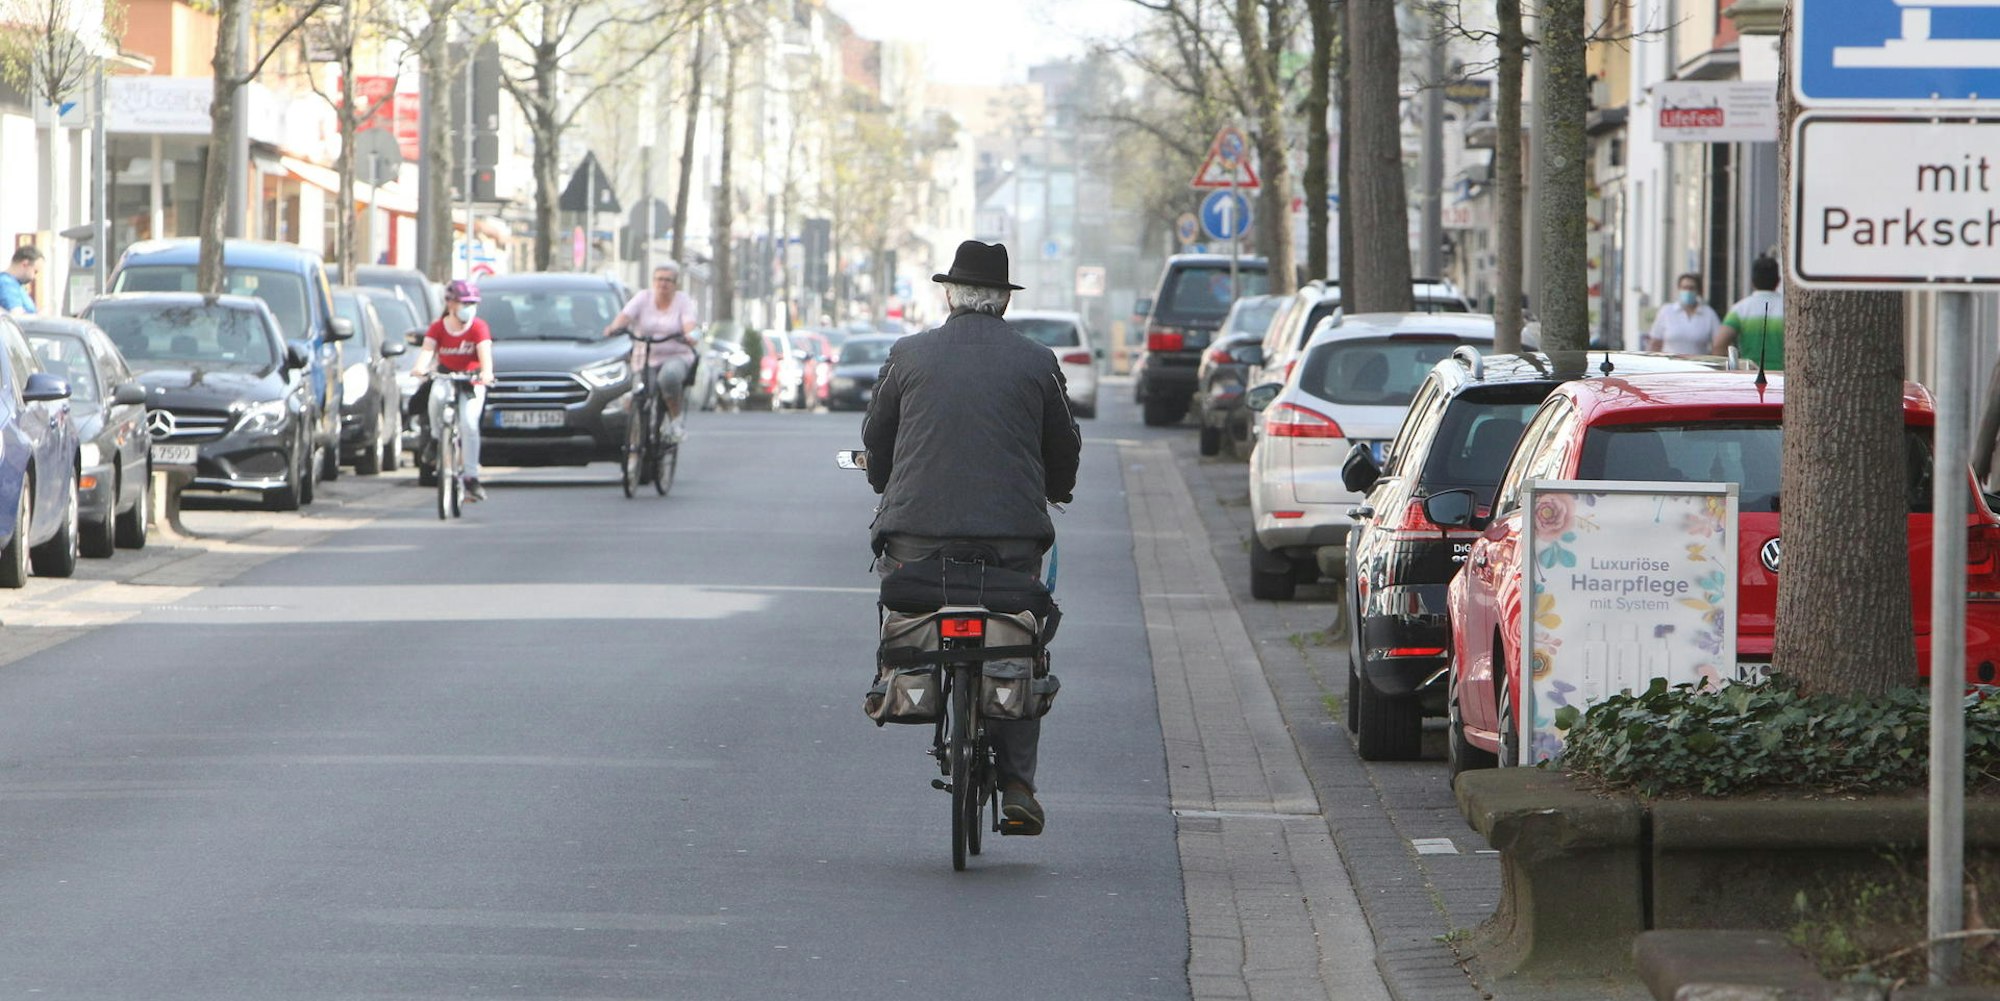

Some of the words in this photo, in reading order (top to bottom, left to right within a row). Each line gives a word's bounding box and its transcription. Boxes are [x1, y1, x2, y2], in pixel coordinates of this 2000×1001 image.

[1917, 154, 1990, 192] mit
[1591, 557, 1670, 571] Luxuriöse
[1571, 574, 1689, 597] Haarpflege
[1590, 597, 1612, 610] mit
[1616, 597, 1670, 612] System
